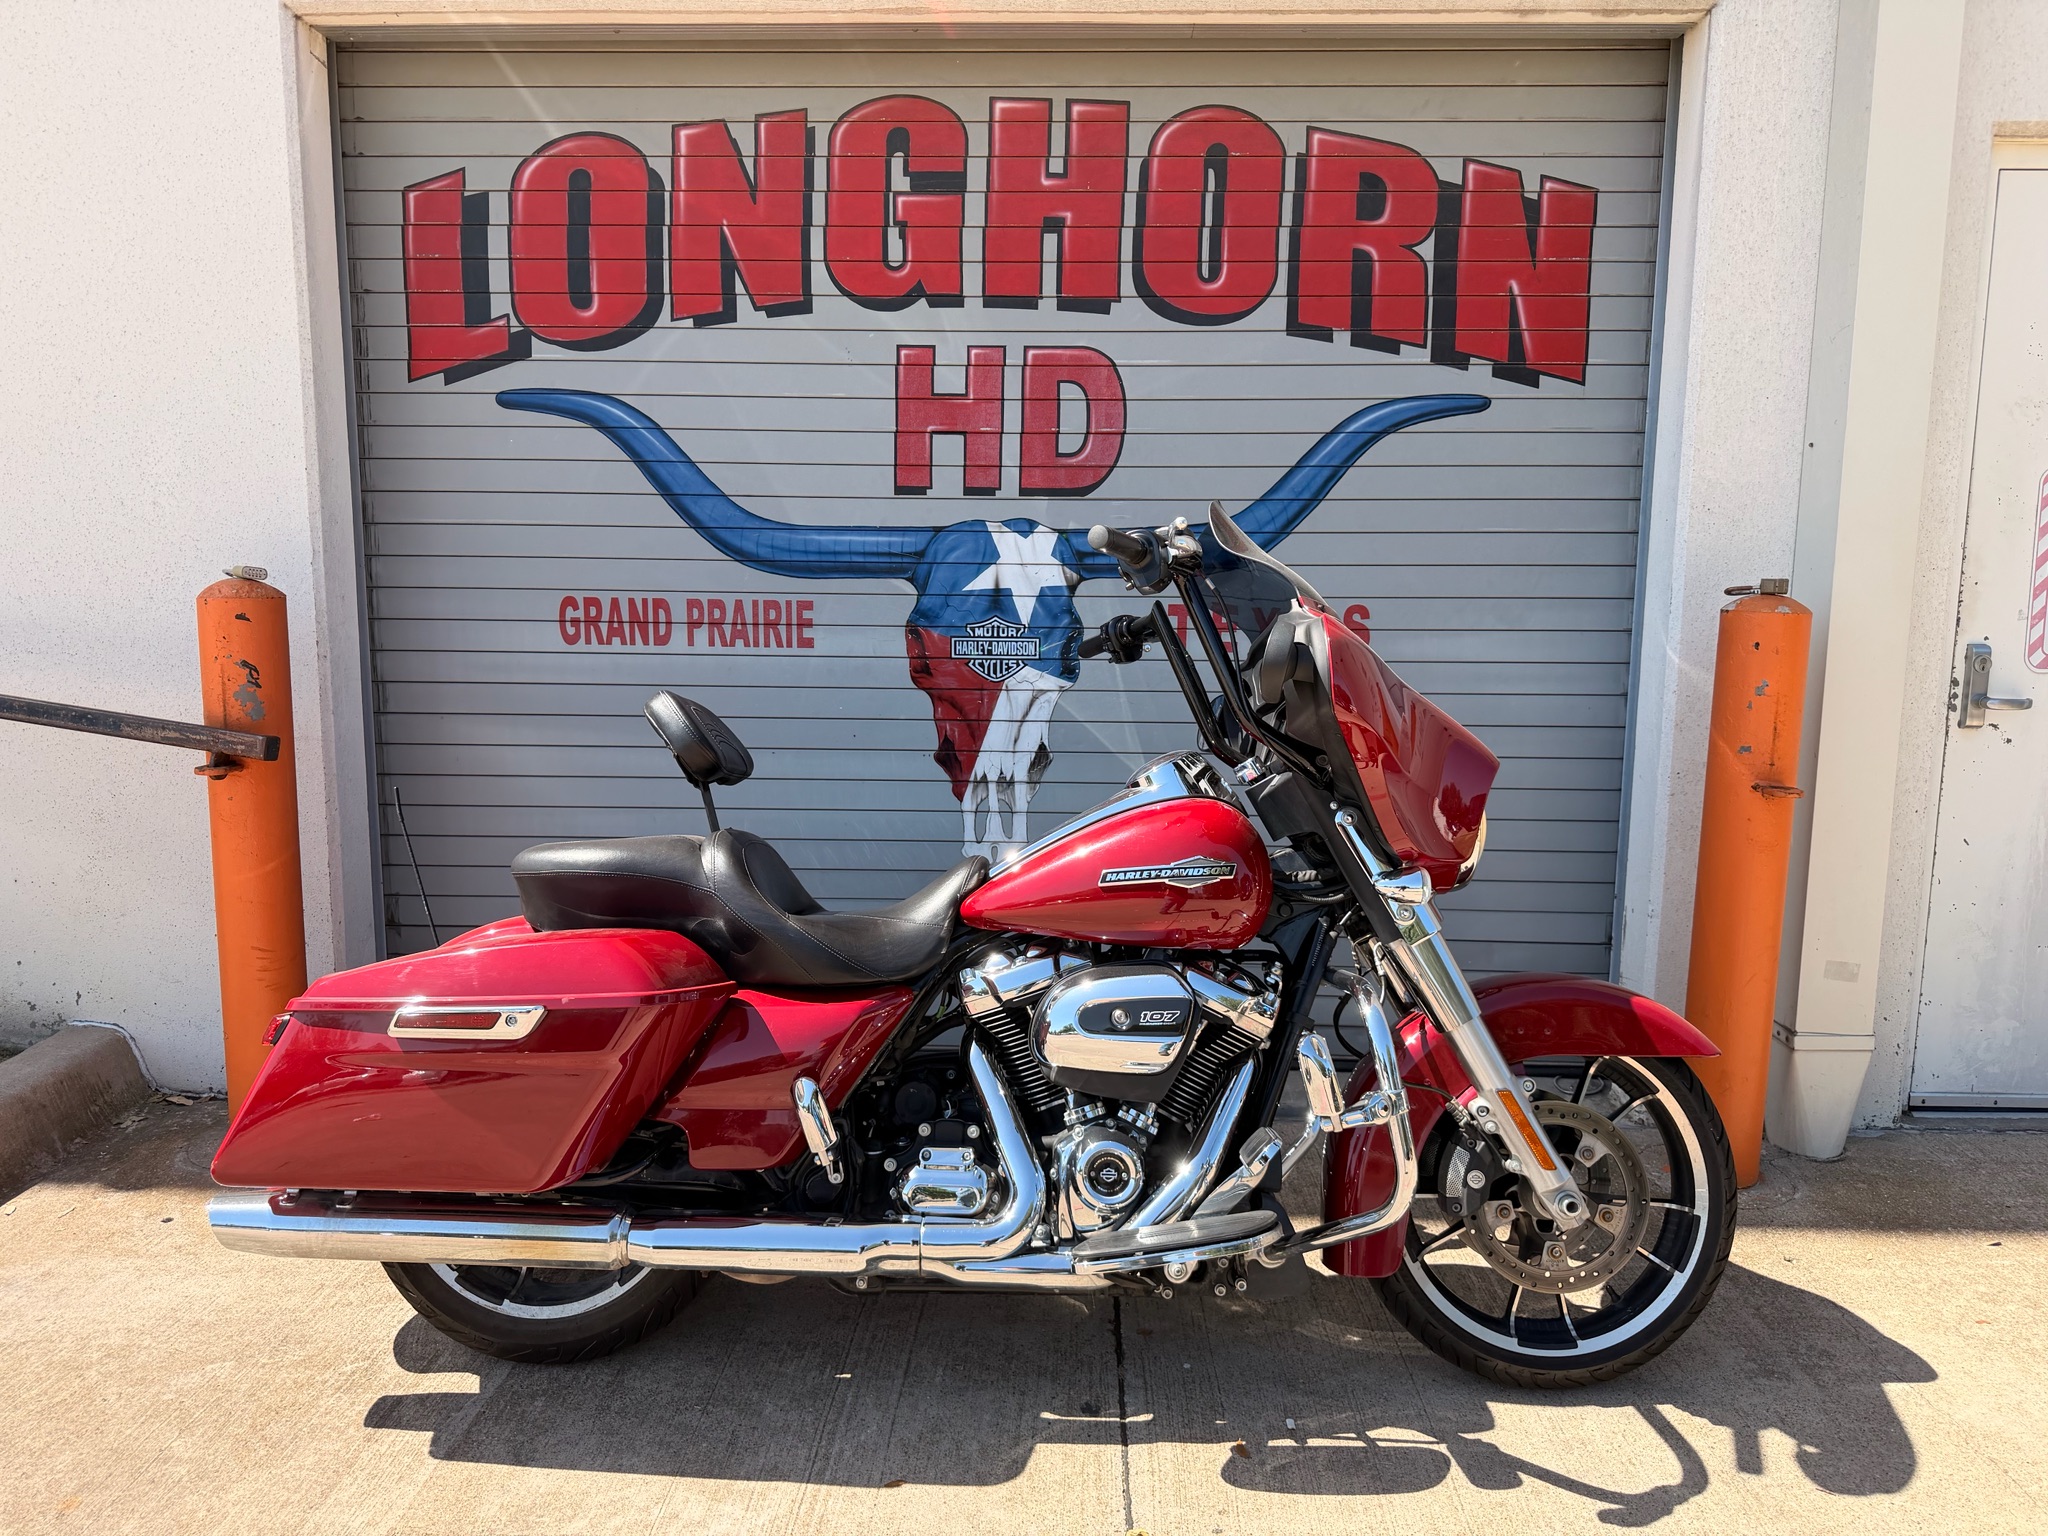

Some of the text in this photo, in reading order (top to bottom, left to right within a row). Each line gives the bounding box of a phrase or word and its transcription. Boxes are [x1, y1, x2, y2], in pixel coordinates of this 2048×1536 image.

[402, 94, 1599, 387] LONGHORN
[894, 344, 1127, 496] HD
[558, 595, 815, 649] GRAND PRAIRIE
[974, 621, 1017, 637] MOTOR
[1167, 603, 1370, 653] TES
[955, 641, 1036, 656] HARLEY-DAVIDSON
[974, 659, 1017, 678] CYCLES
[1105, 866, 1231, 882] HARLEY-DAVIDSON
[1140, 1010, 1181, 1023] 107
